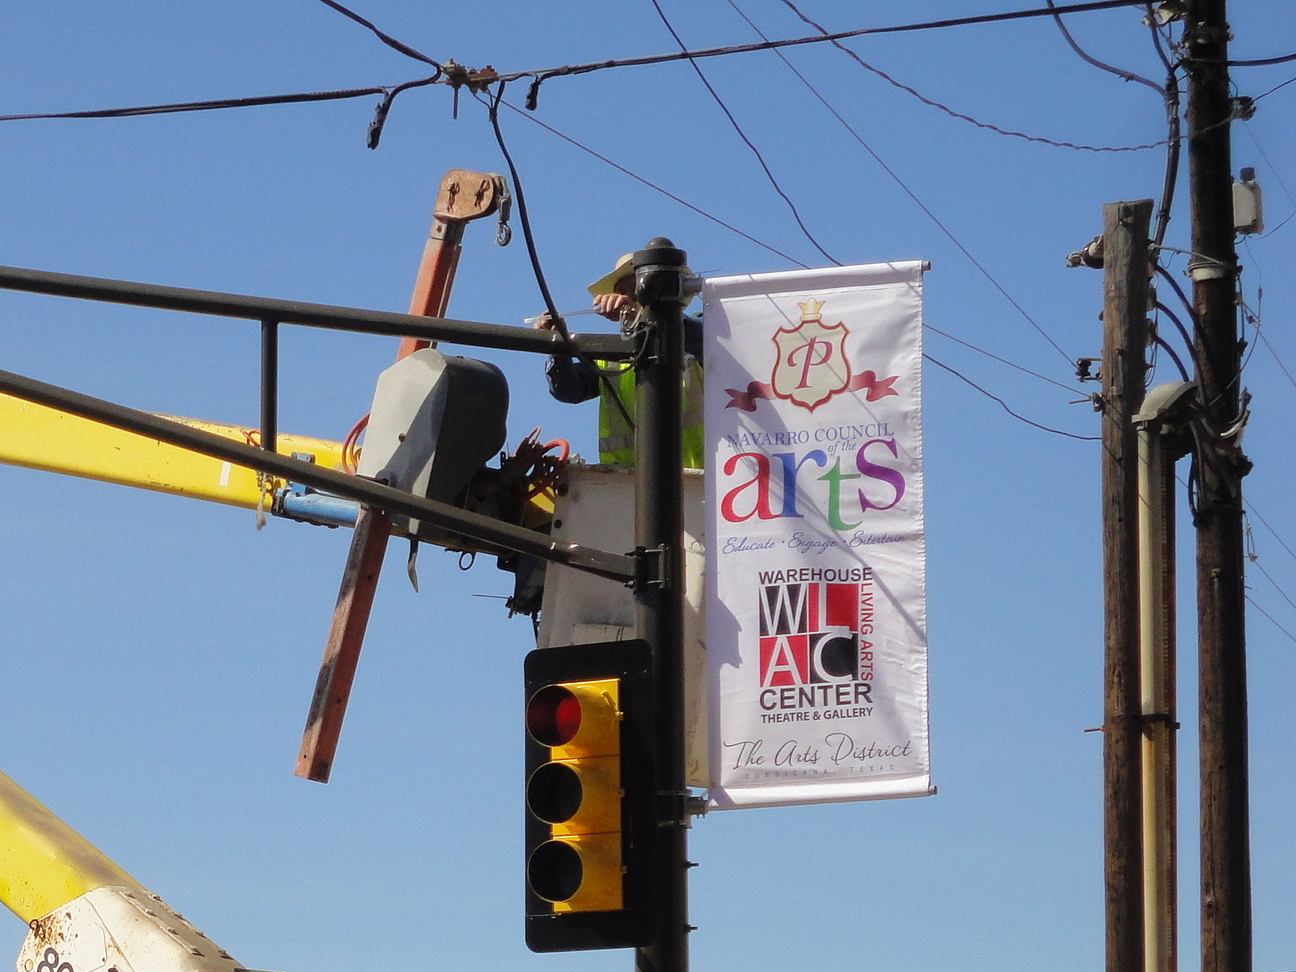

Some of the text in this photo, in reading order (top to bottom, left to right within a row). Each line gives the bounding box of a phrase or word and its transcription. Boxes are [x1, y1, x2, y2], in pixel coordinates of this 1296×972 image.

[787, 336, 833, 390] P
[726, 422, 895, 448] NAVARRO COUNCIL
[828, 441, 857, 455] of the
[720, 437, 906, 531] arts
[722, 530, 907, 555] Educate Engage Entertain
[758, 567, 873, 585] WAREHOUSE
[860, 583, 874, 681] LIVING ARTS
[759, 682, 873, 711] CENTER
[761, 707, 874, 724] THEATRE & GALLERY
[723, 732, 913, 770] The Arts District
[849, 764, 895, 773] TEXAS
